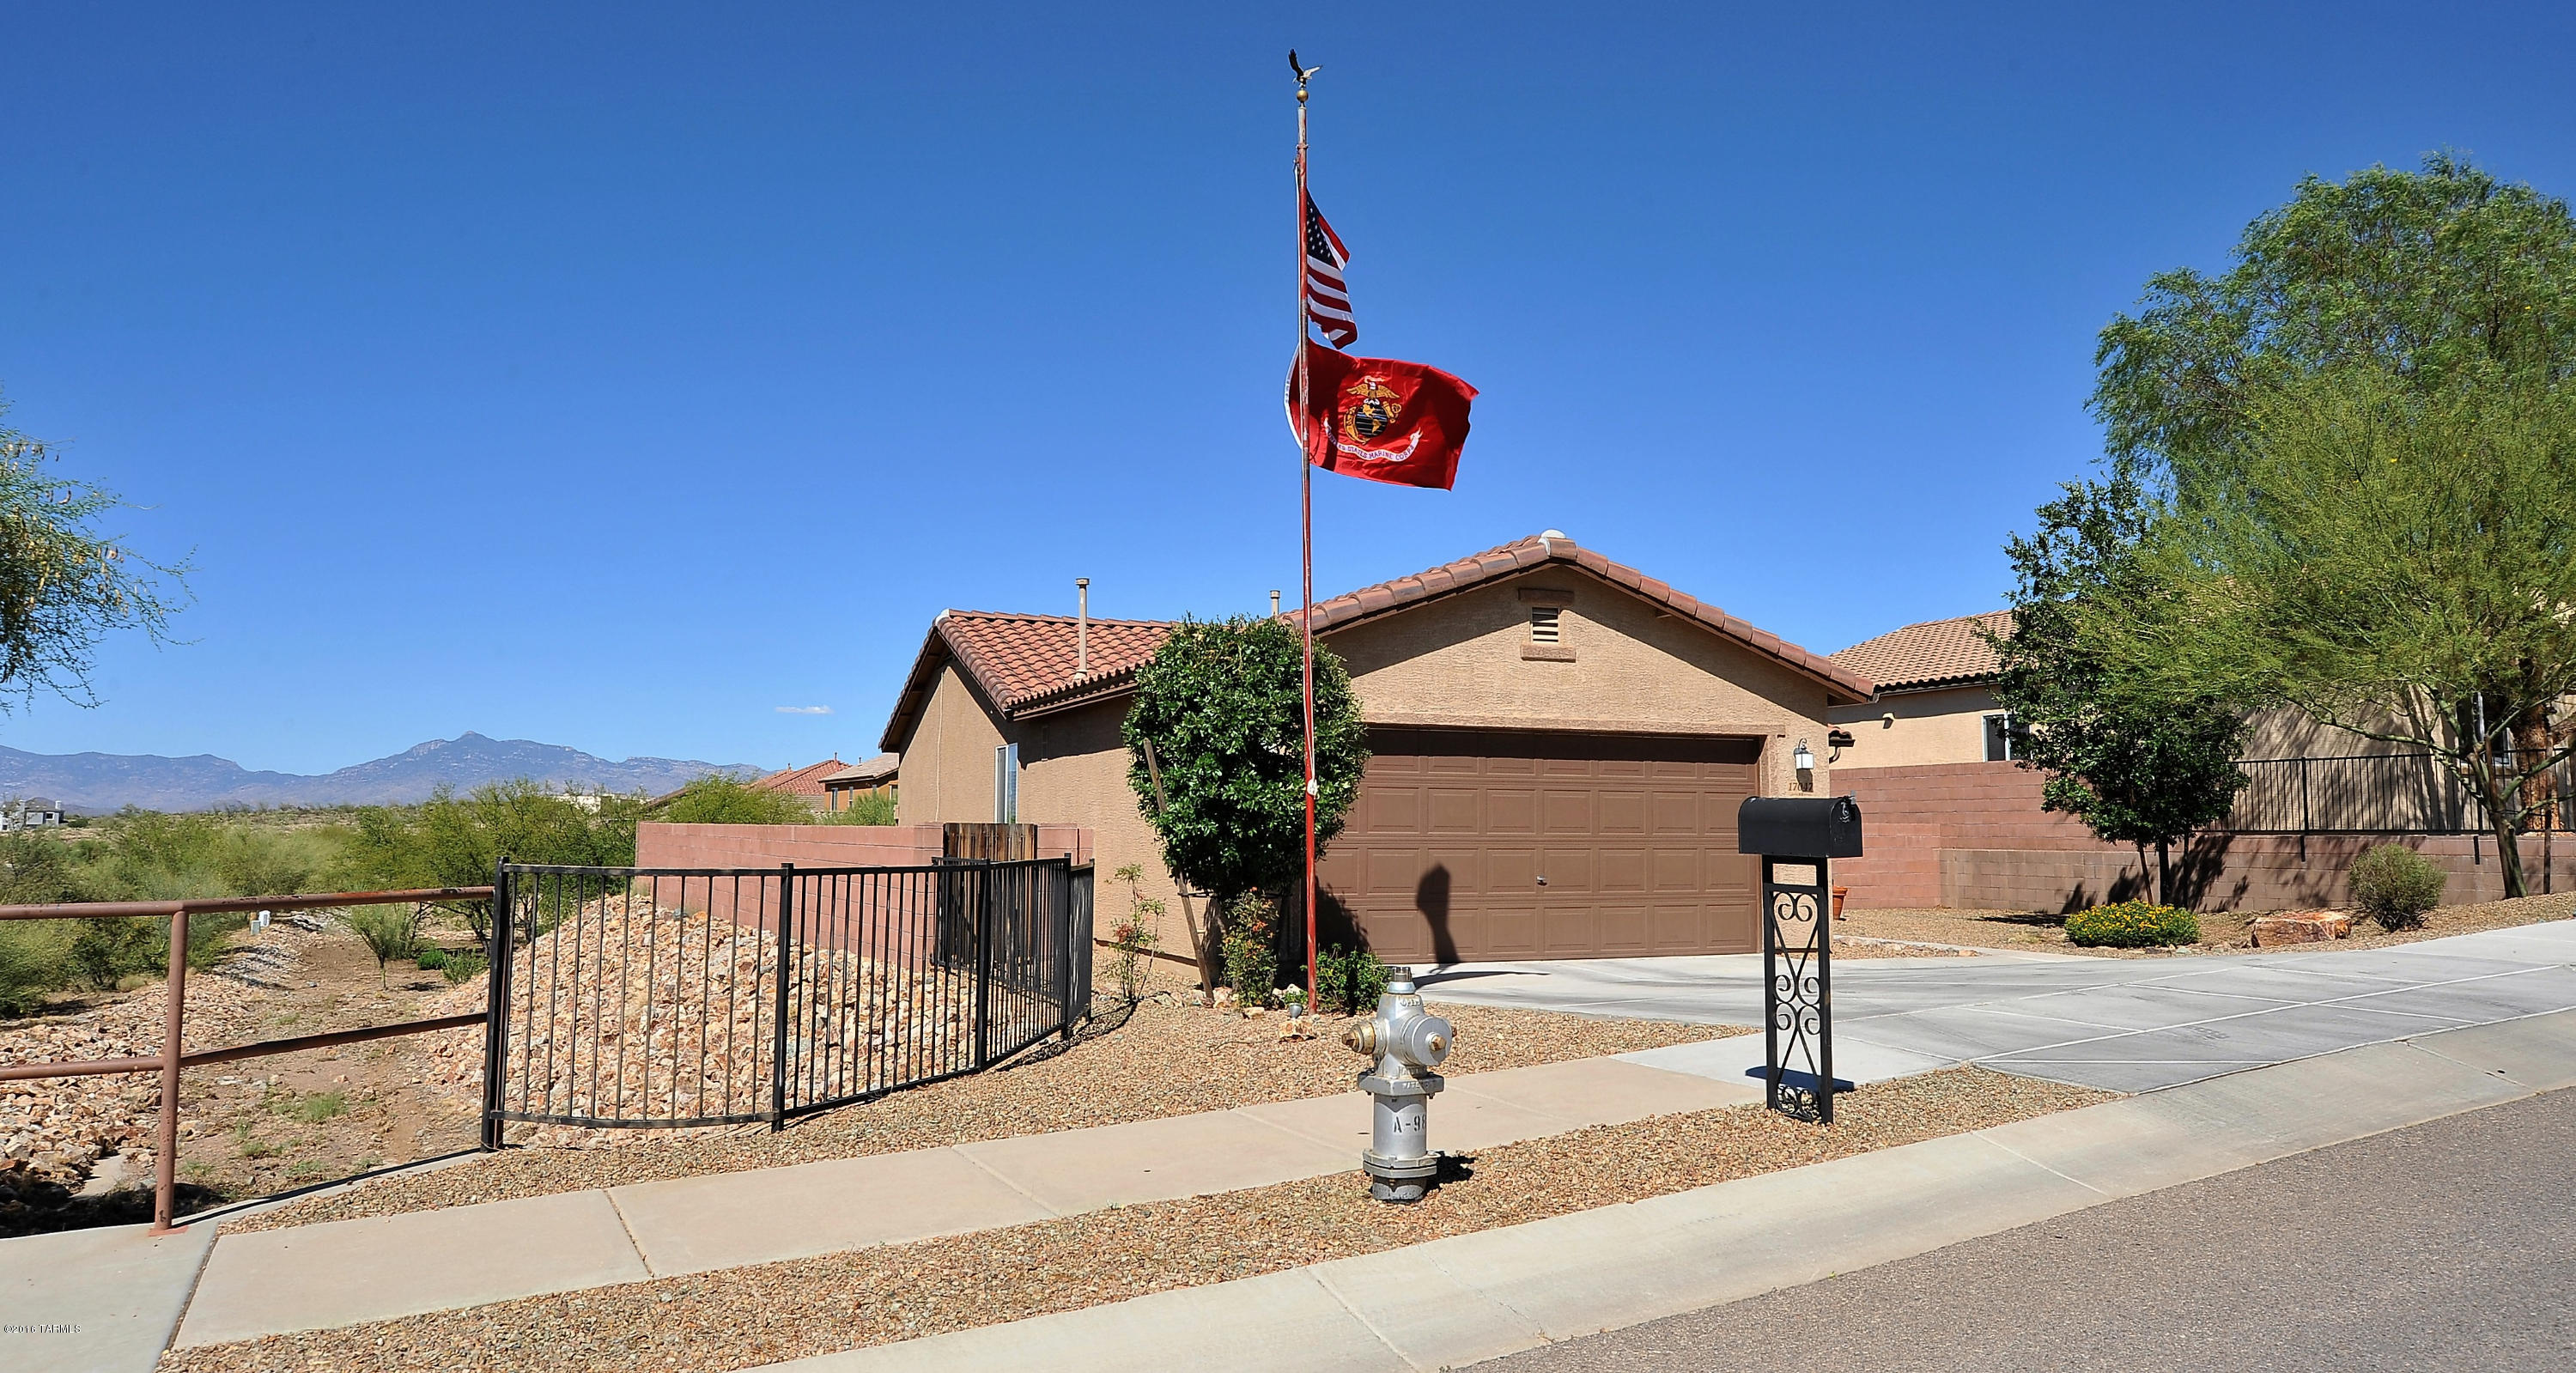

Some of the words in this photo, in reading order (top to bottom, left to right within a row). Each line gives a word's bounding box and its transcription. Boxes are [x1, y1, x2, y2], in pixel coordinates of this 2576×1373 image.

[1347, 445, 1368, 459] STATES
[1369, 449, 1394, 459] MARINE
[1395, 445, 1415, 461] CORPS
